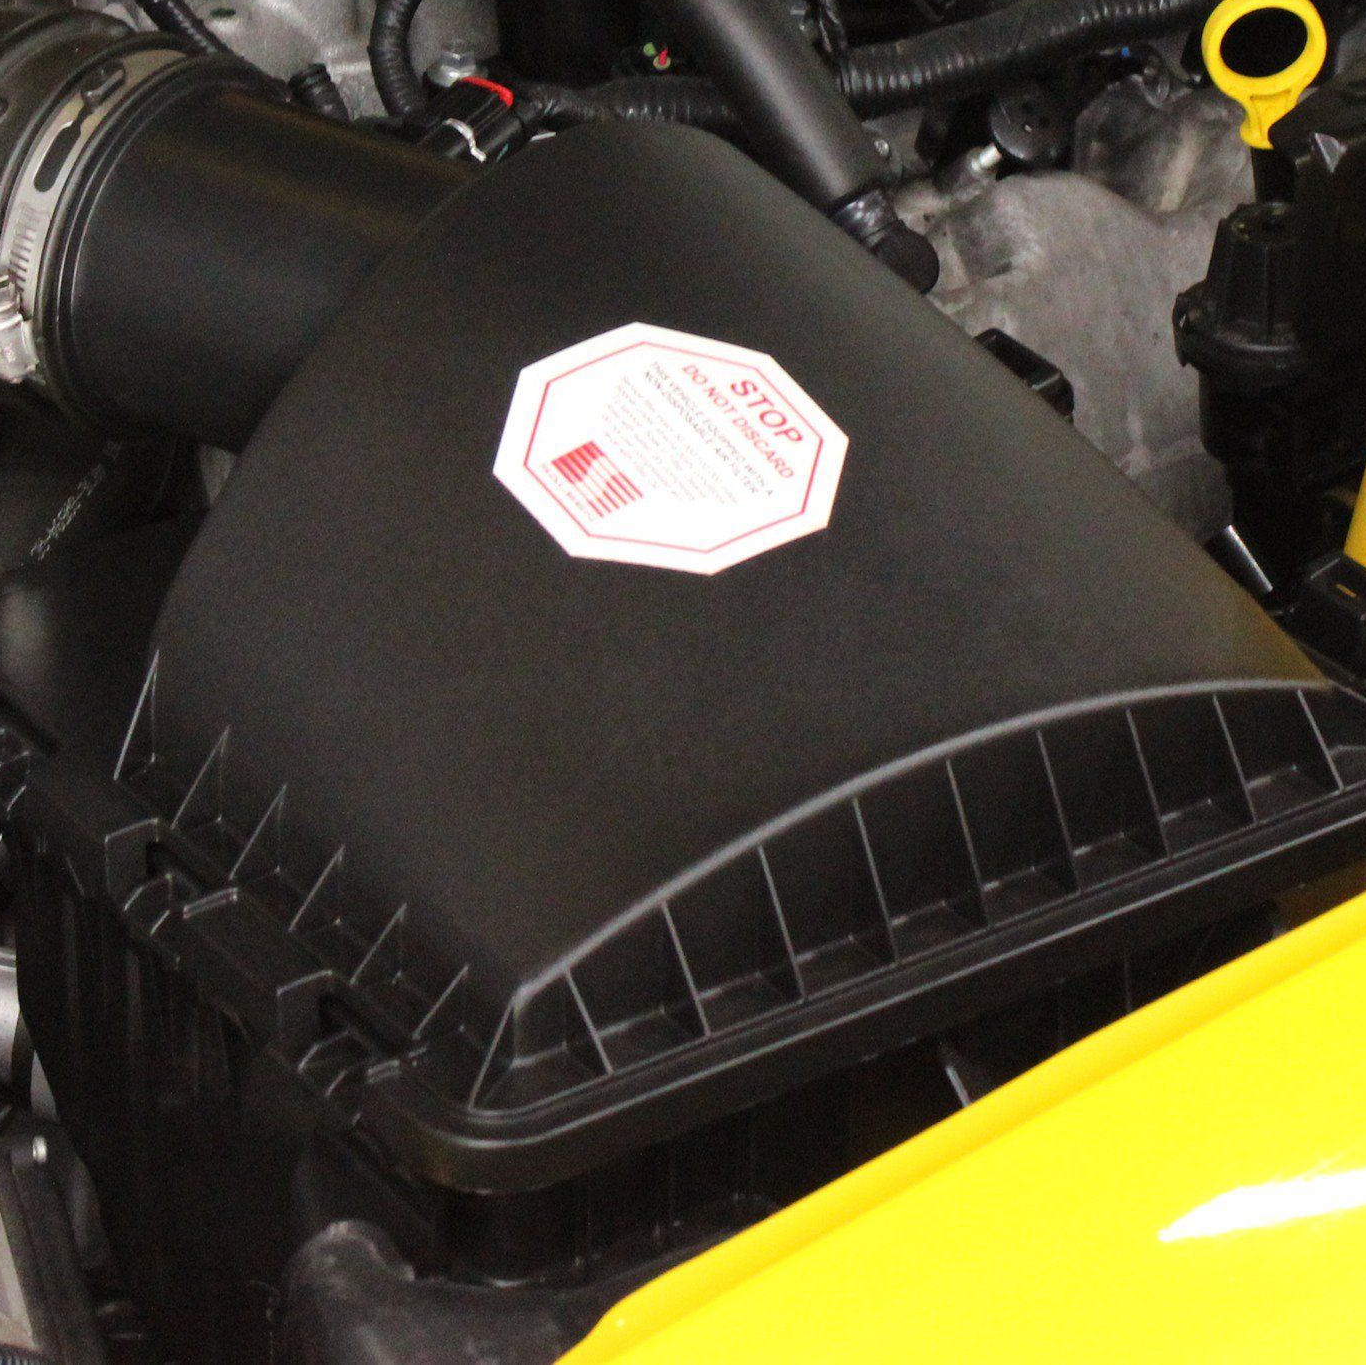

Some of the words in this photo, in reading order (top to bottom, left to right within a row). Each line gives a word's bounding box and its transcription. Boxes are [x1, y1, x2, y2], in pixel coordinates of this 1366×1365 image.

[682, 363, 709, 387] DO
[704, 385, 738, 415] NOT
[732, 415, 795, 479] DISCARD
[730, 379, 804, 443] STOP
